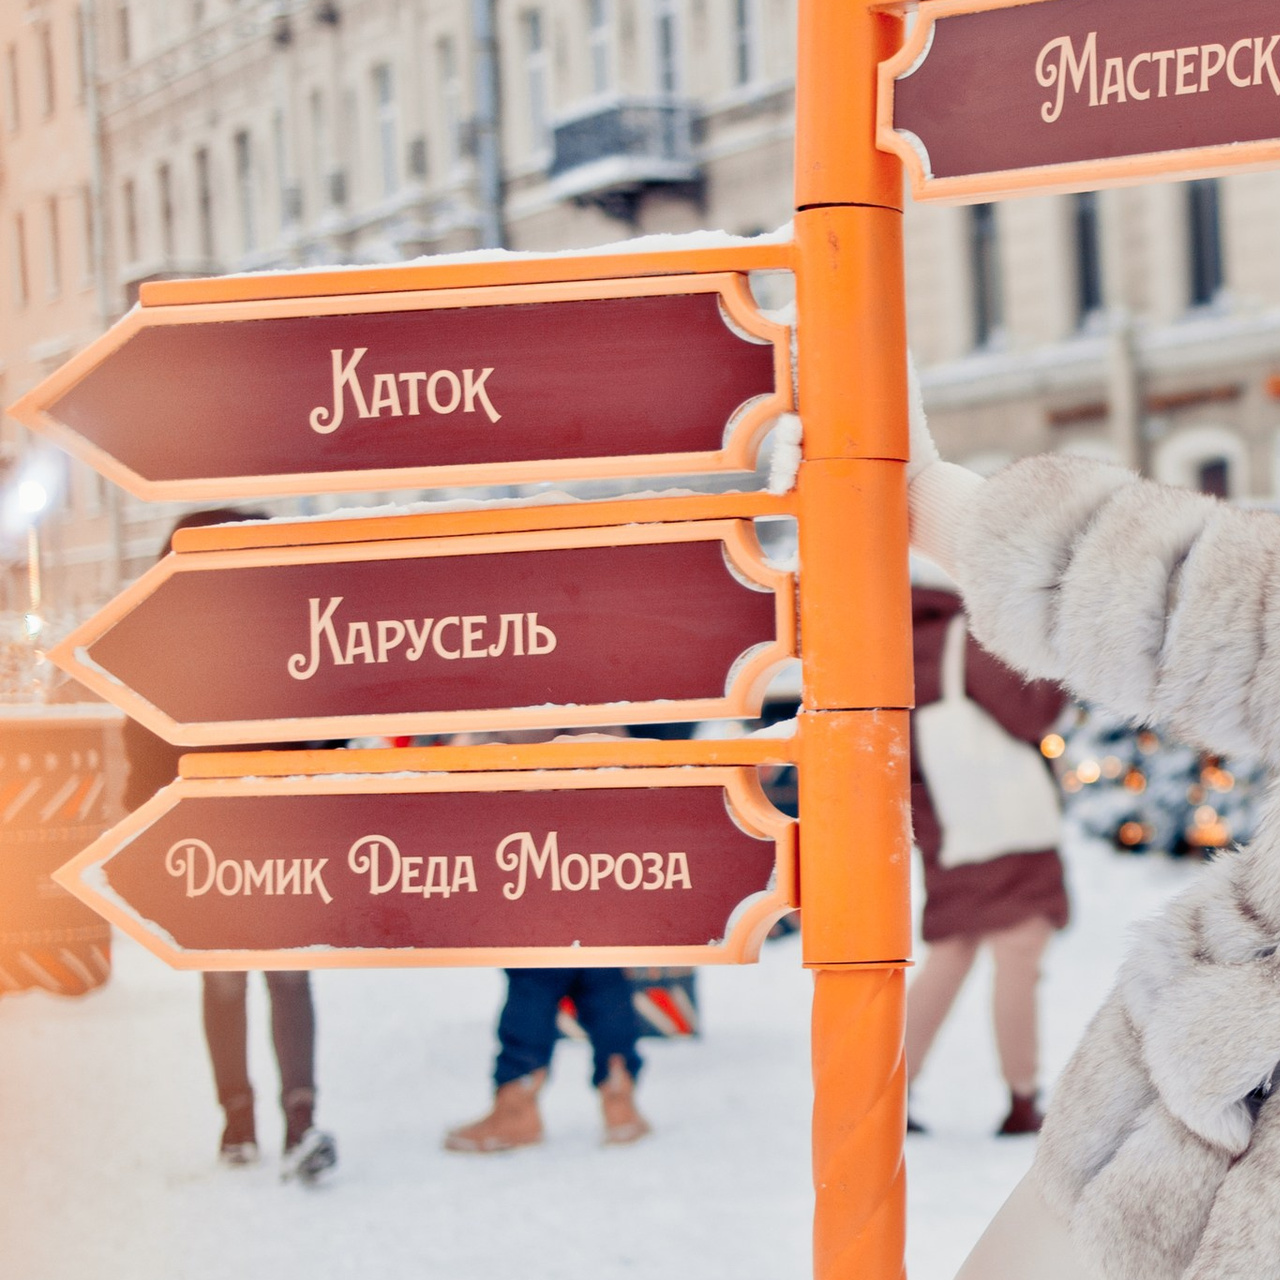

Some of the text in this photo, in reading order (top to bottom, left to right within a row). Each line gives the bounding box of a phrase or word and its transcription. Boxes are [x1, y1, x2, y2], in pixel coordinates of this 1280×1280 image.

[310, 348, 502, 434] Каток
[288, 597, 557, 680] Карусель
[165, 832, 693, 905] Домик Деда Мороза
